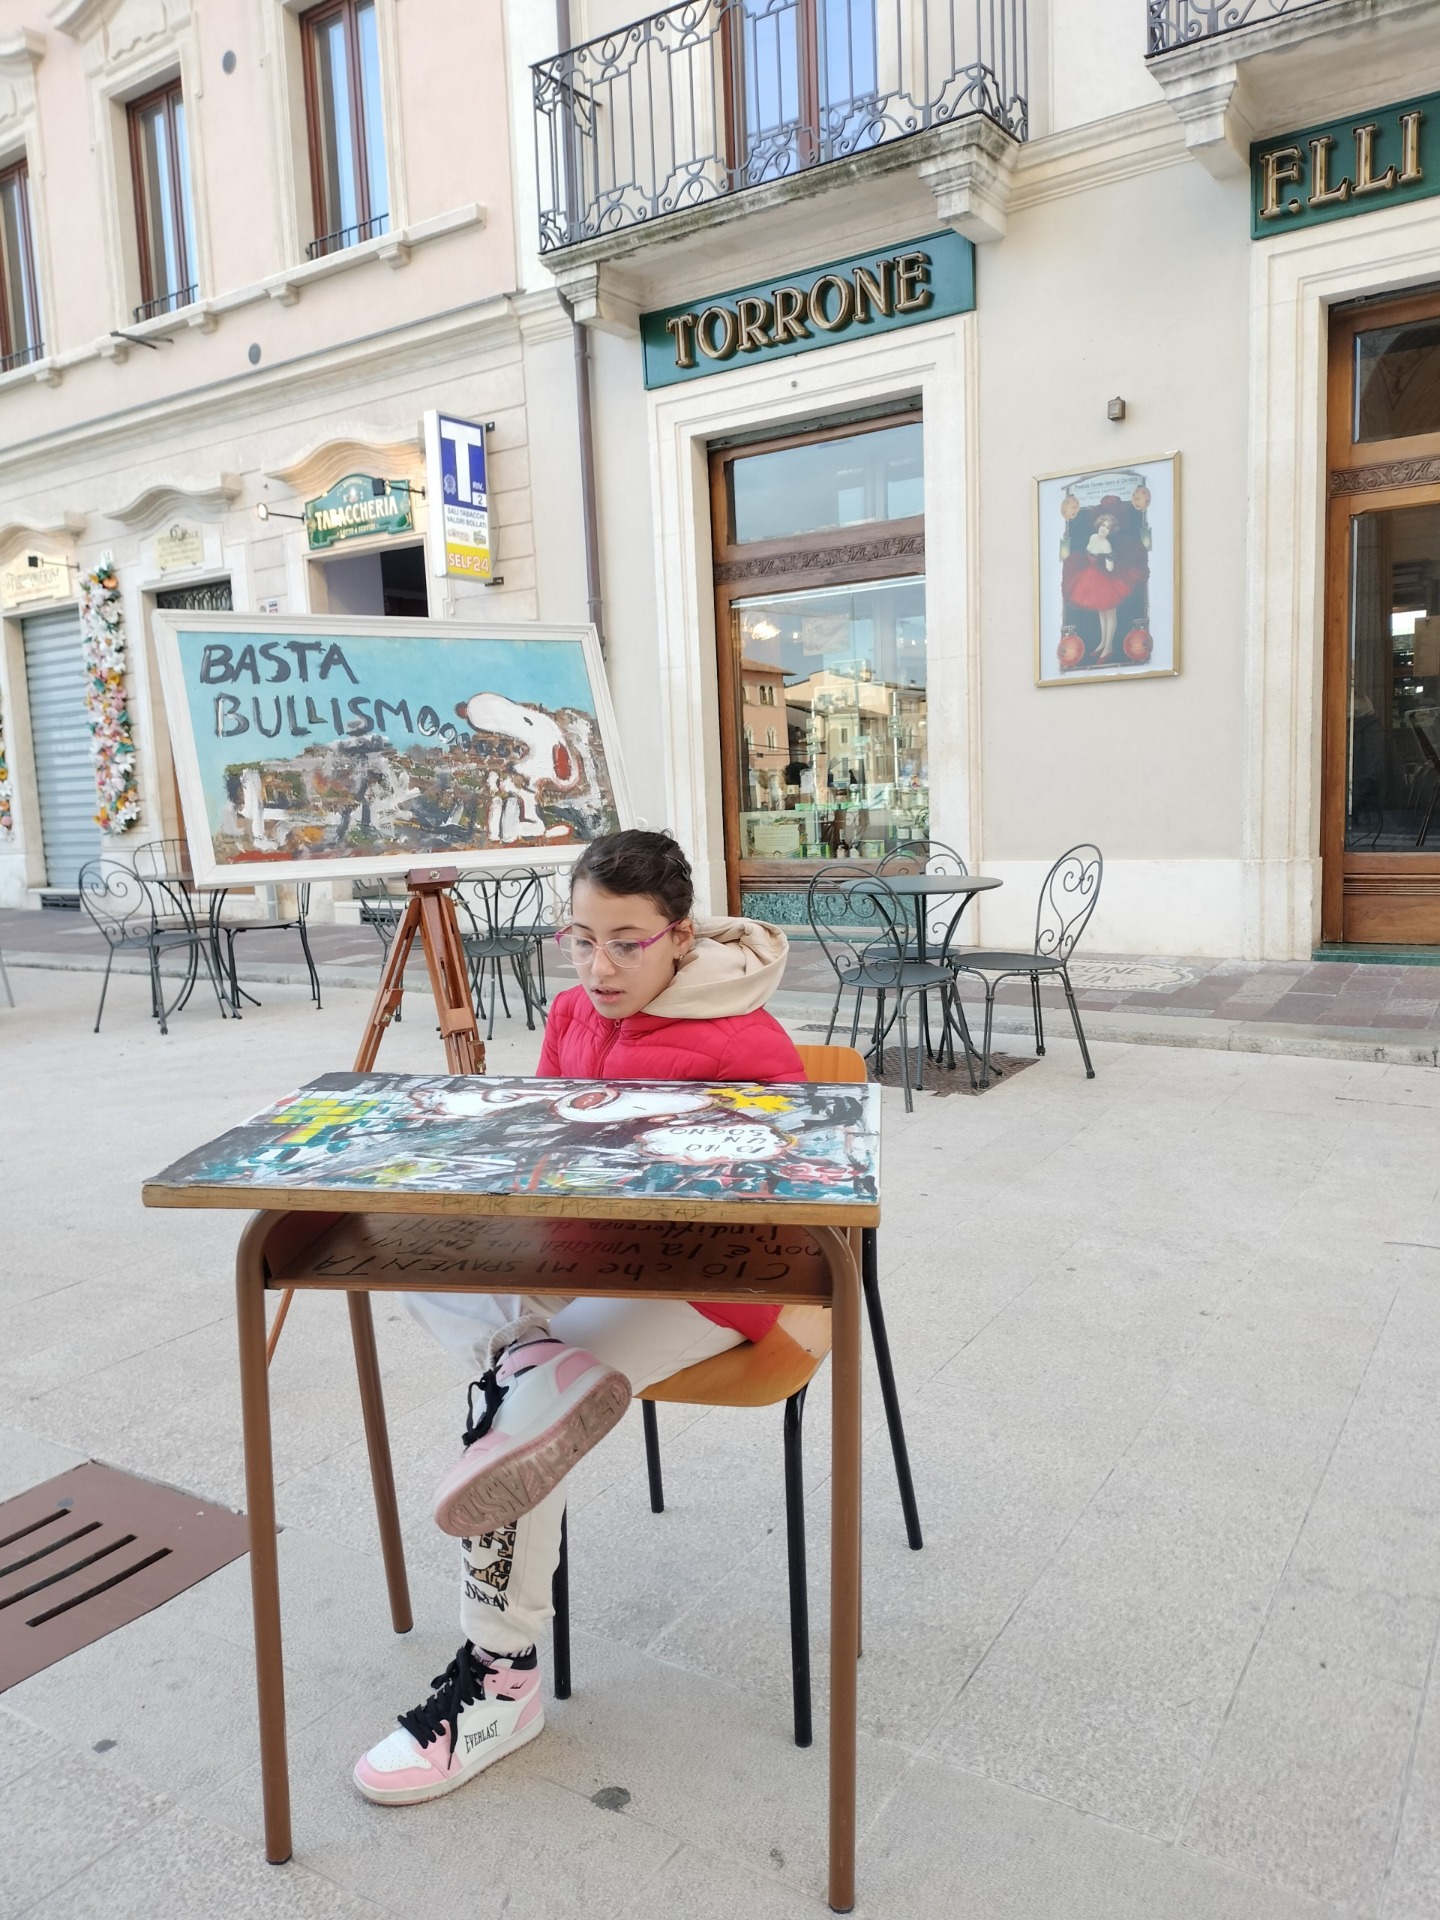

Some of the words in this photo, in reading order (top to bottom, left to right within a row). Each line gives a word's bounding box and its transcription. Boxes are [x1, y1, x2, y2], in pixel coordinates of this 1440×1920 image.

[1259, 110, 1424, 220] F.LLI
[666, 250, 935, 368] TORRONE
[440, 418, 482, 503] T
[472, 481, 485, 491] RIV.
[477, 495, 484, 505] 2
[314, 495, 399, 532] TABACCHERIA
[446, 516, 466, 526] VALORI
[465, 519, 487, 529] BOLLATI
[447, 507, 459, 516] SALI
[460, 509, 485, 520] TABACCHI
[199, 641, 360, 684] BASTA
[669, 1127, 766, 1137] SOGNO
[723, 1136, 768, 1144] UN
[660, 1242, 700, 1260] la
[764, 1244, 822, 1257] non
[313, 1255, 523, 1276] SPAVENTA
[535, 1257, 578, 1275] MI
[598, 1262, 673, 1281] che
[463, 1719, 500, 1754] EVERLAST
